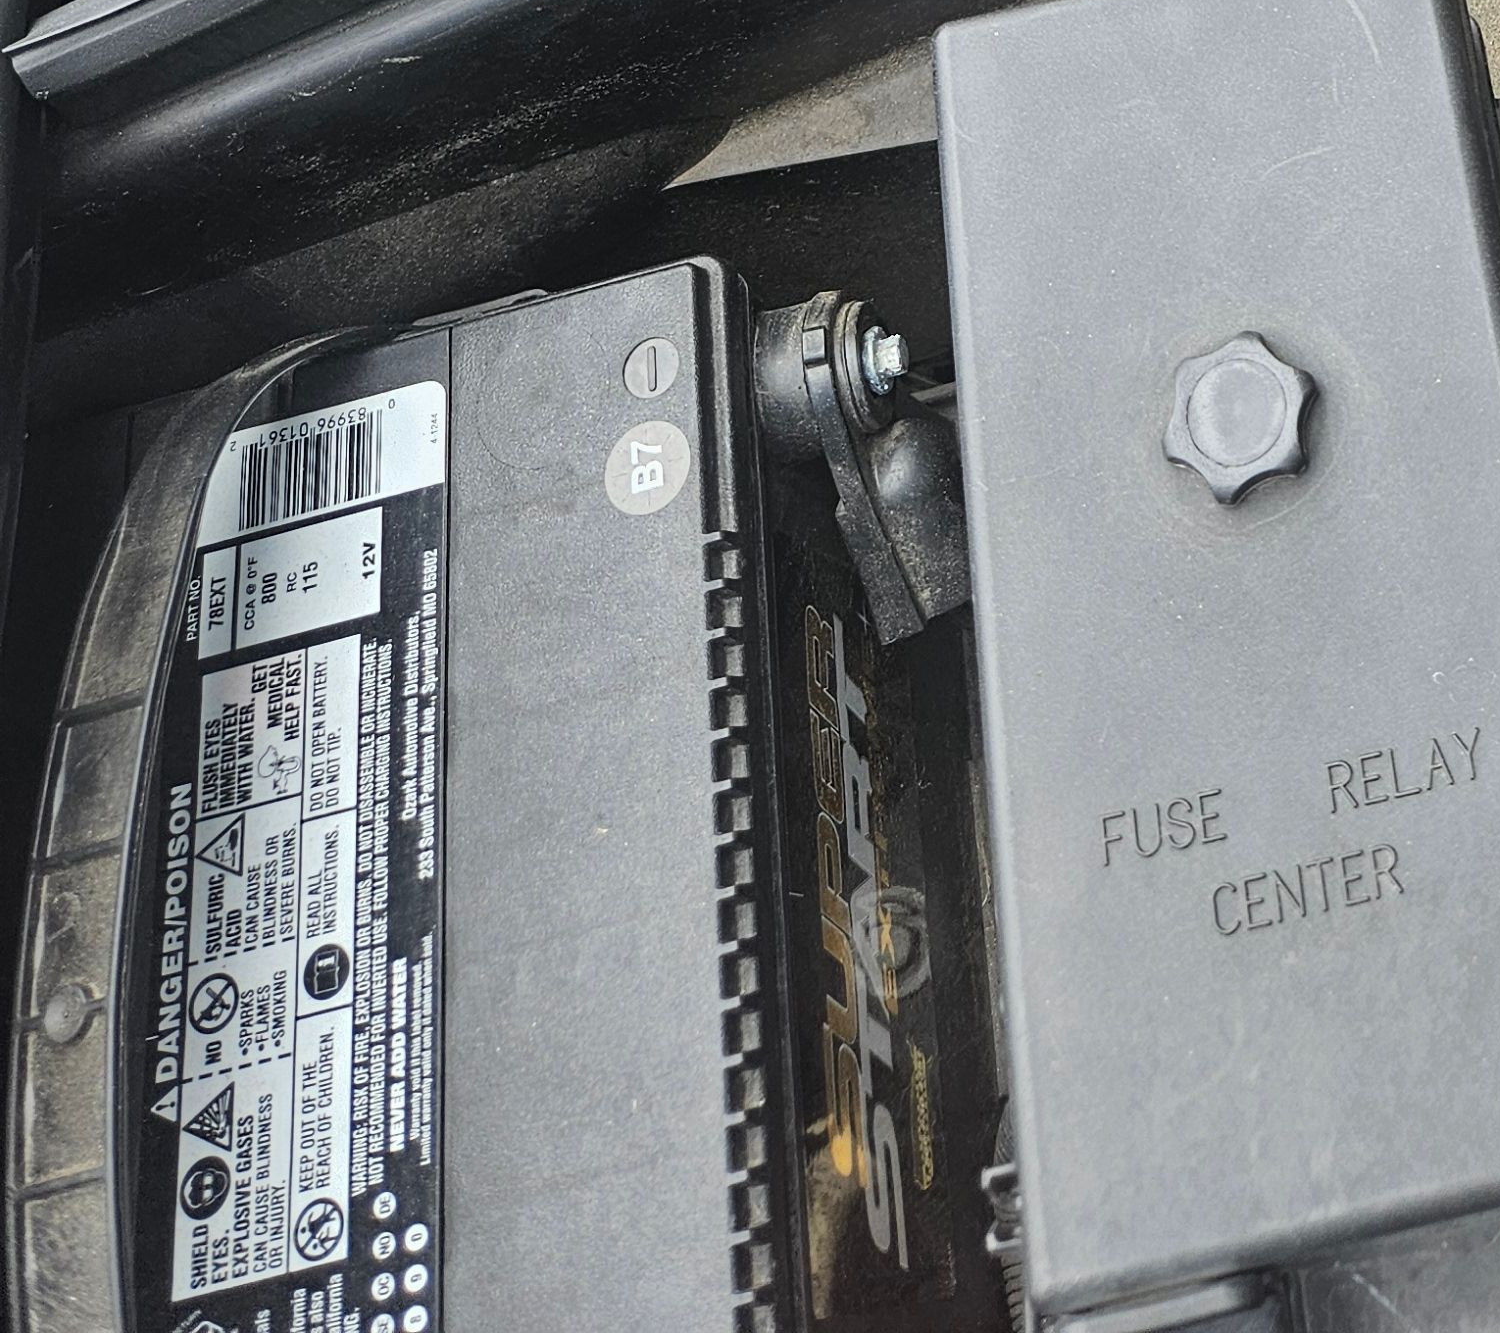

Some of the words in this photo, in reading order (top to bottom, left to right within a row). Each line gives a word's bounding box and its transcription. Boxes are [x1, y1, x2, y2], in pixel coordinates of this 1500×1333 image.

[257, 421, 310, 449] 01361
[318, 407, 367, 431] 83996
[629, 440, 668, 498] B7
[287, 572, 297, 592] RC
[302, 562, 318, 593] 115
[362, 543, 375, 579] 12V
[188, 573, 203, 604] NO.
[208, 578, 226, 630] 78EXT
[261, 573, 277, 604] 800
[185, 605, 201, 641] PART
[244, 599, 256, 630] CCA
[252, 665, 267, 693] GET
[267, 656, 284, 728] MEDICAL
[285, 651, 301, 697] FAST.
[313, 657, 327, 716] BATTERY.
[204, 719, 221, 757] EYES
[238, 698, 255, 754] WATER.
[284, 703, 299, 741] HELP
[312, 721, 325, 755] OPEN
[327, 728, 341, 751] TIP.
[219, 703, 240, 808] IMMEDIATELY
[311, 762, 324, 787] NOT
[326, 758, 340, 782] NOT
[201, 762, 219, 813] FLUSH
[236, 757, 252, 807] WITH
[310, 792, 324, 812] DO
[325, 788, 339, 807] DO
[1100, 787, 1229, 867] FUSE
[1324, 726, 1484, 814] RELAY
[266, 835, 278, 855] OR
[282, 828, 296, 876] BURNS.
[246, 866, 260, 910] CAUSE
[262, 860, 277, 939] BLINDNESS
[308, 871, 322, 895] ALL
[323, 831, 338, 934] INSTRUCTIONS.
[805, 603, 868, 1191] SUPER
[1210, 844, 1405, 936] CENTER
[206, 874, 224, 953] SULFURIC
[226, 909, 241, 947] ACID
[245, 915, 258, 943] CAN
[280, 881, 294, 934] SEVERE
[306, 901, 320, 938] READ
[155, 781, 193, 1086] DANGER/POISON
[834, 609, 910, 1273] START
[255, 985, 270, 1043] FLAMES
[272, 970, 286, 1039] SMOKING
[392, 957, 407, 1028] WATER
[239, 990, 254, 1050] SPARKS
[205, 1041, 221, 1065] NO
[314, 1033, 333, 1109] CHILDREN.
[391, 1032, 405, 1077] ADD
[303, 1062, 316, 1090] THE
[302, 1096, 316, 1114] OF
[318, 1115, 331, 1140] OF
[390, 1083, 405, 1152] NEVER
[236, 1115, 253, 1172] GASES
[256, 1094, 272, 1180] BLINDNESS
[301, 1120, 315, 1148] OUT
[299, 1155, 314, 1192] KEEP
[316, 1143, 331, 1188] REACH
[232, 1178, 251, 1278] EXPLOSIVE
[254, 1187, 269, 1235] CAUSE
[270, 1187, 285, 1240] INJURY.
[191, 1224, 208, 1289] SHIELD
[211, 1230, 229, 1284] EYES.
[253, 1241, 267, 1272] CAN
[268, 1246, 283, 1268] OR
